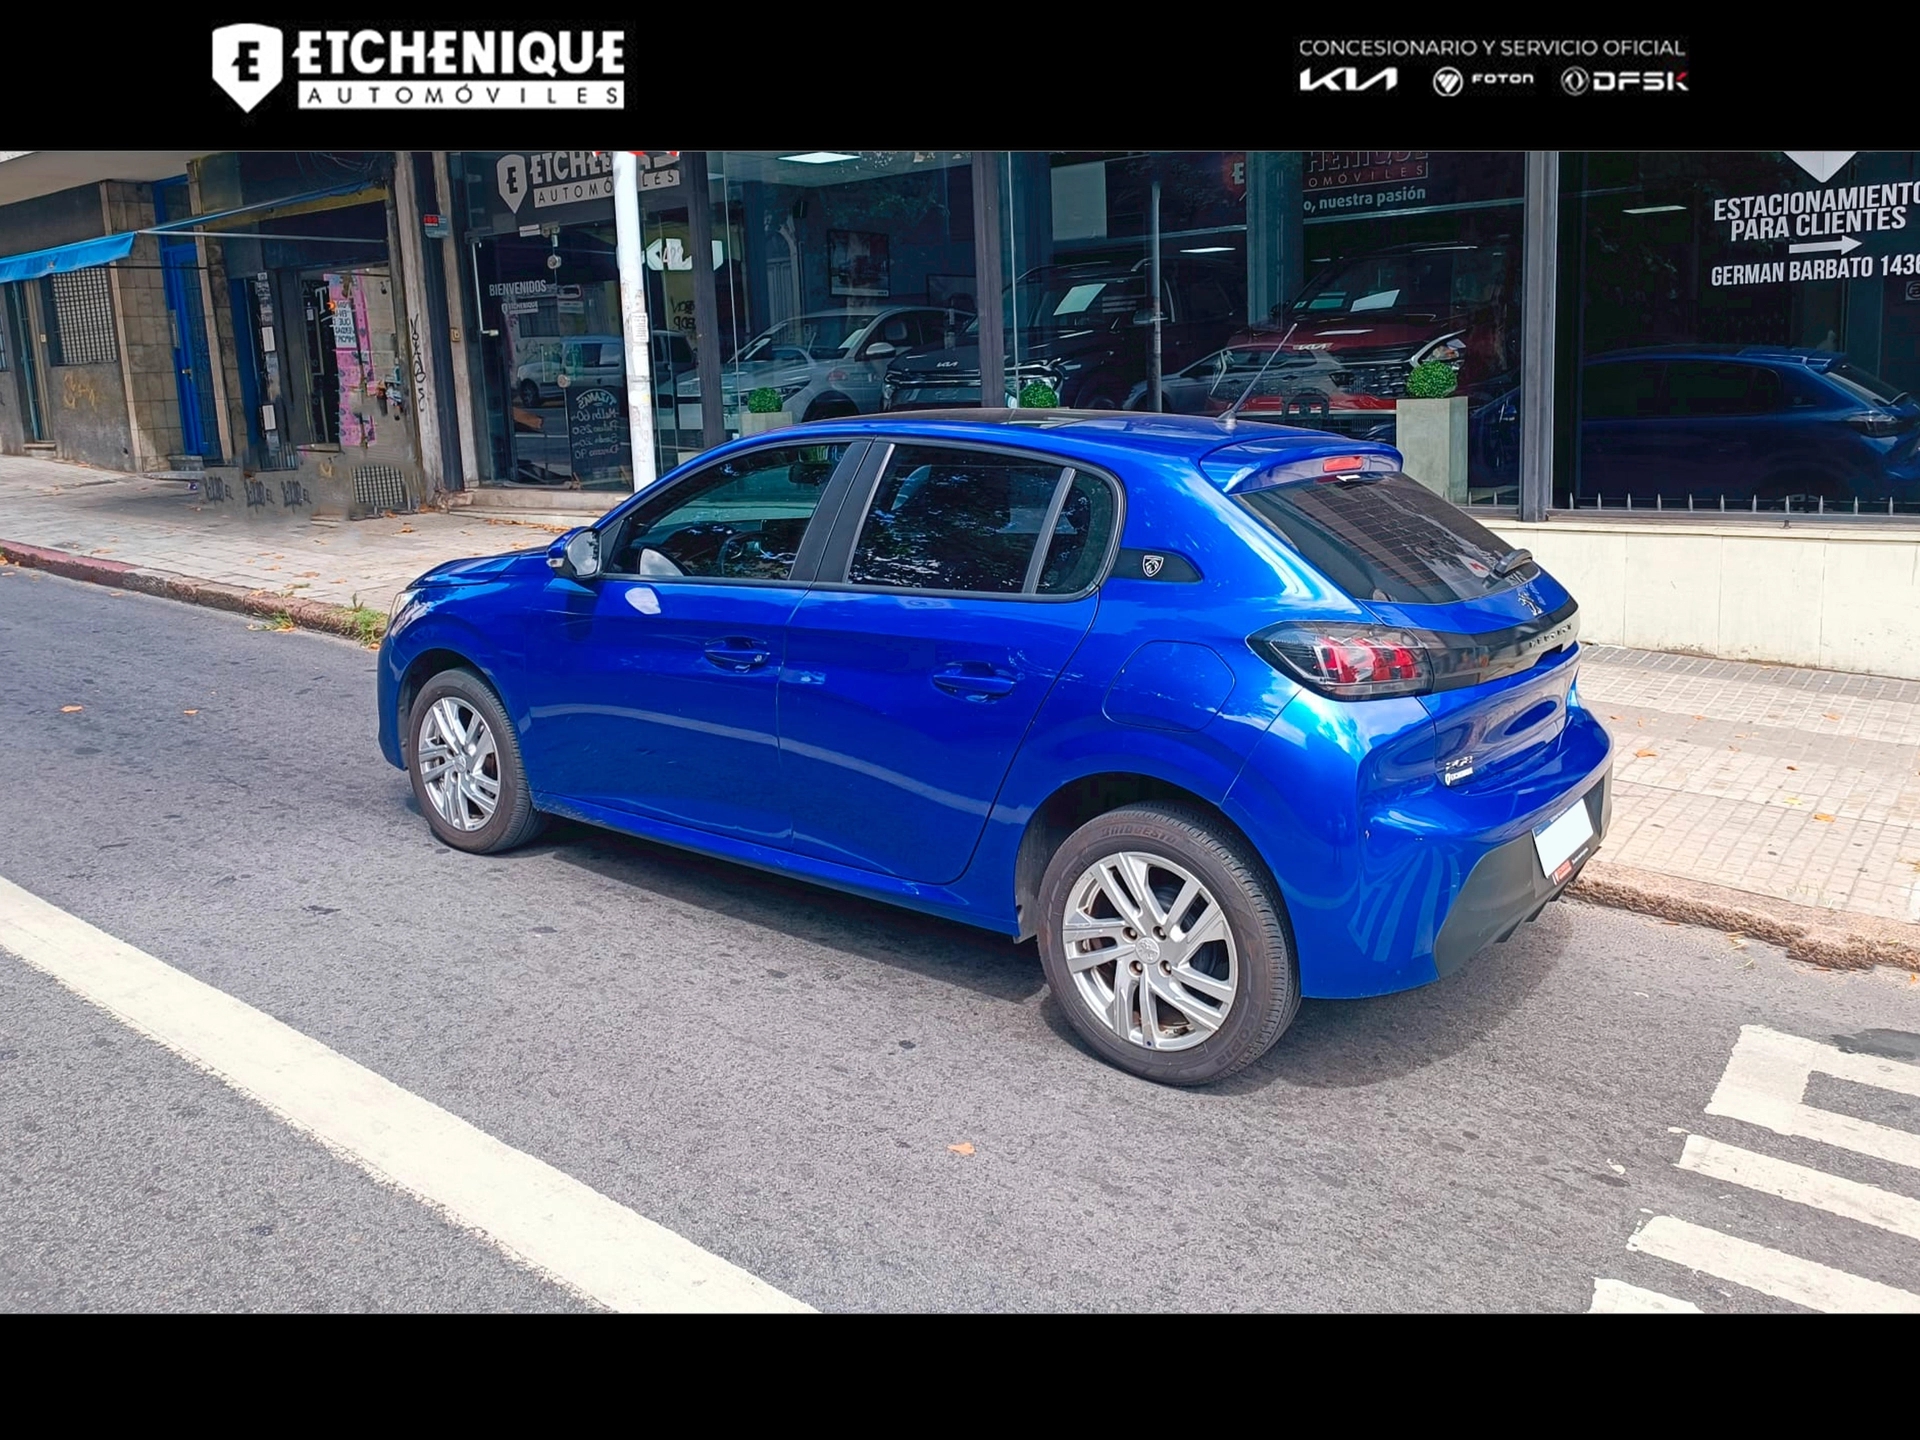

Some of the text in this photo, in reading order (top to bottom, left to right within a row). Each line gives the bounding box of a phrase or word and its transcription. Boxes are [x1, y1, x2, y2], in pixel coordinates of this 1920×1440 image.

[1319, 192, 1373, 210] nuestra
[1377, 185, 1426, 207] pasión
[1731, 206, 1907, 242] PARA CLIENTES
[1711, 261, 1785, 287] GERMAN
[1789, 256, 1873, 282] BARBATO
[489, 279, 547, 297] BIENVENIDOS
